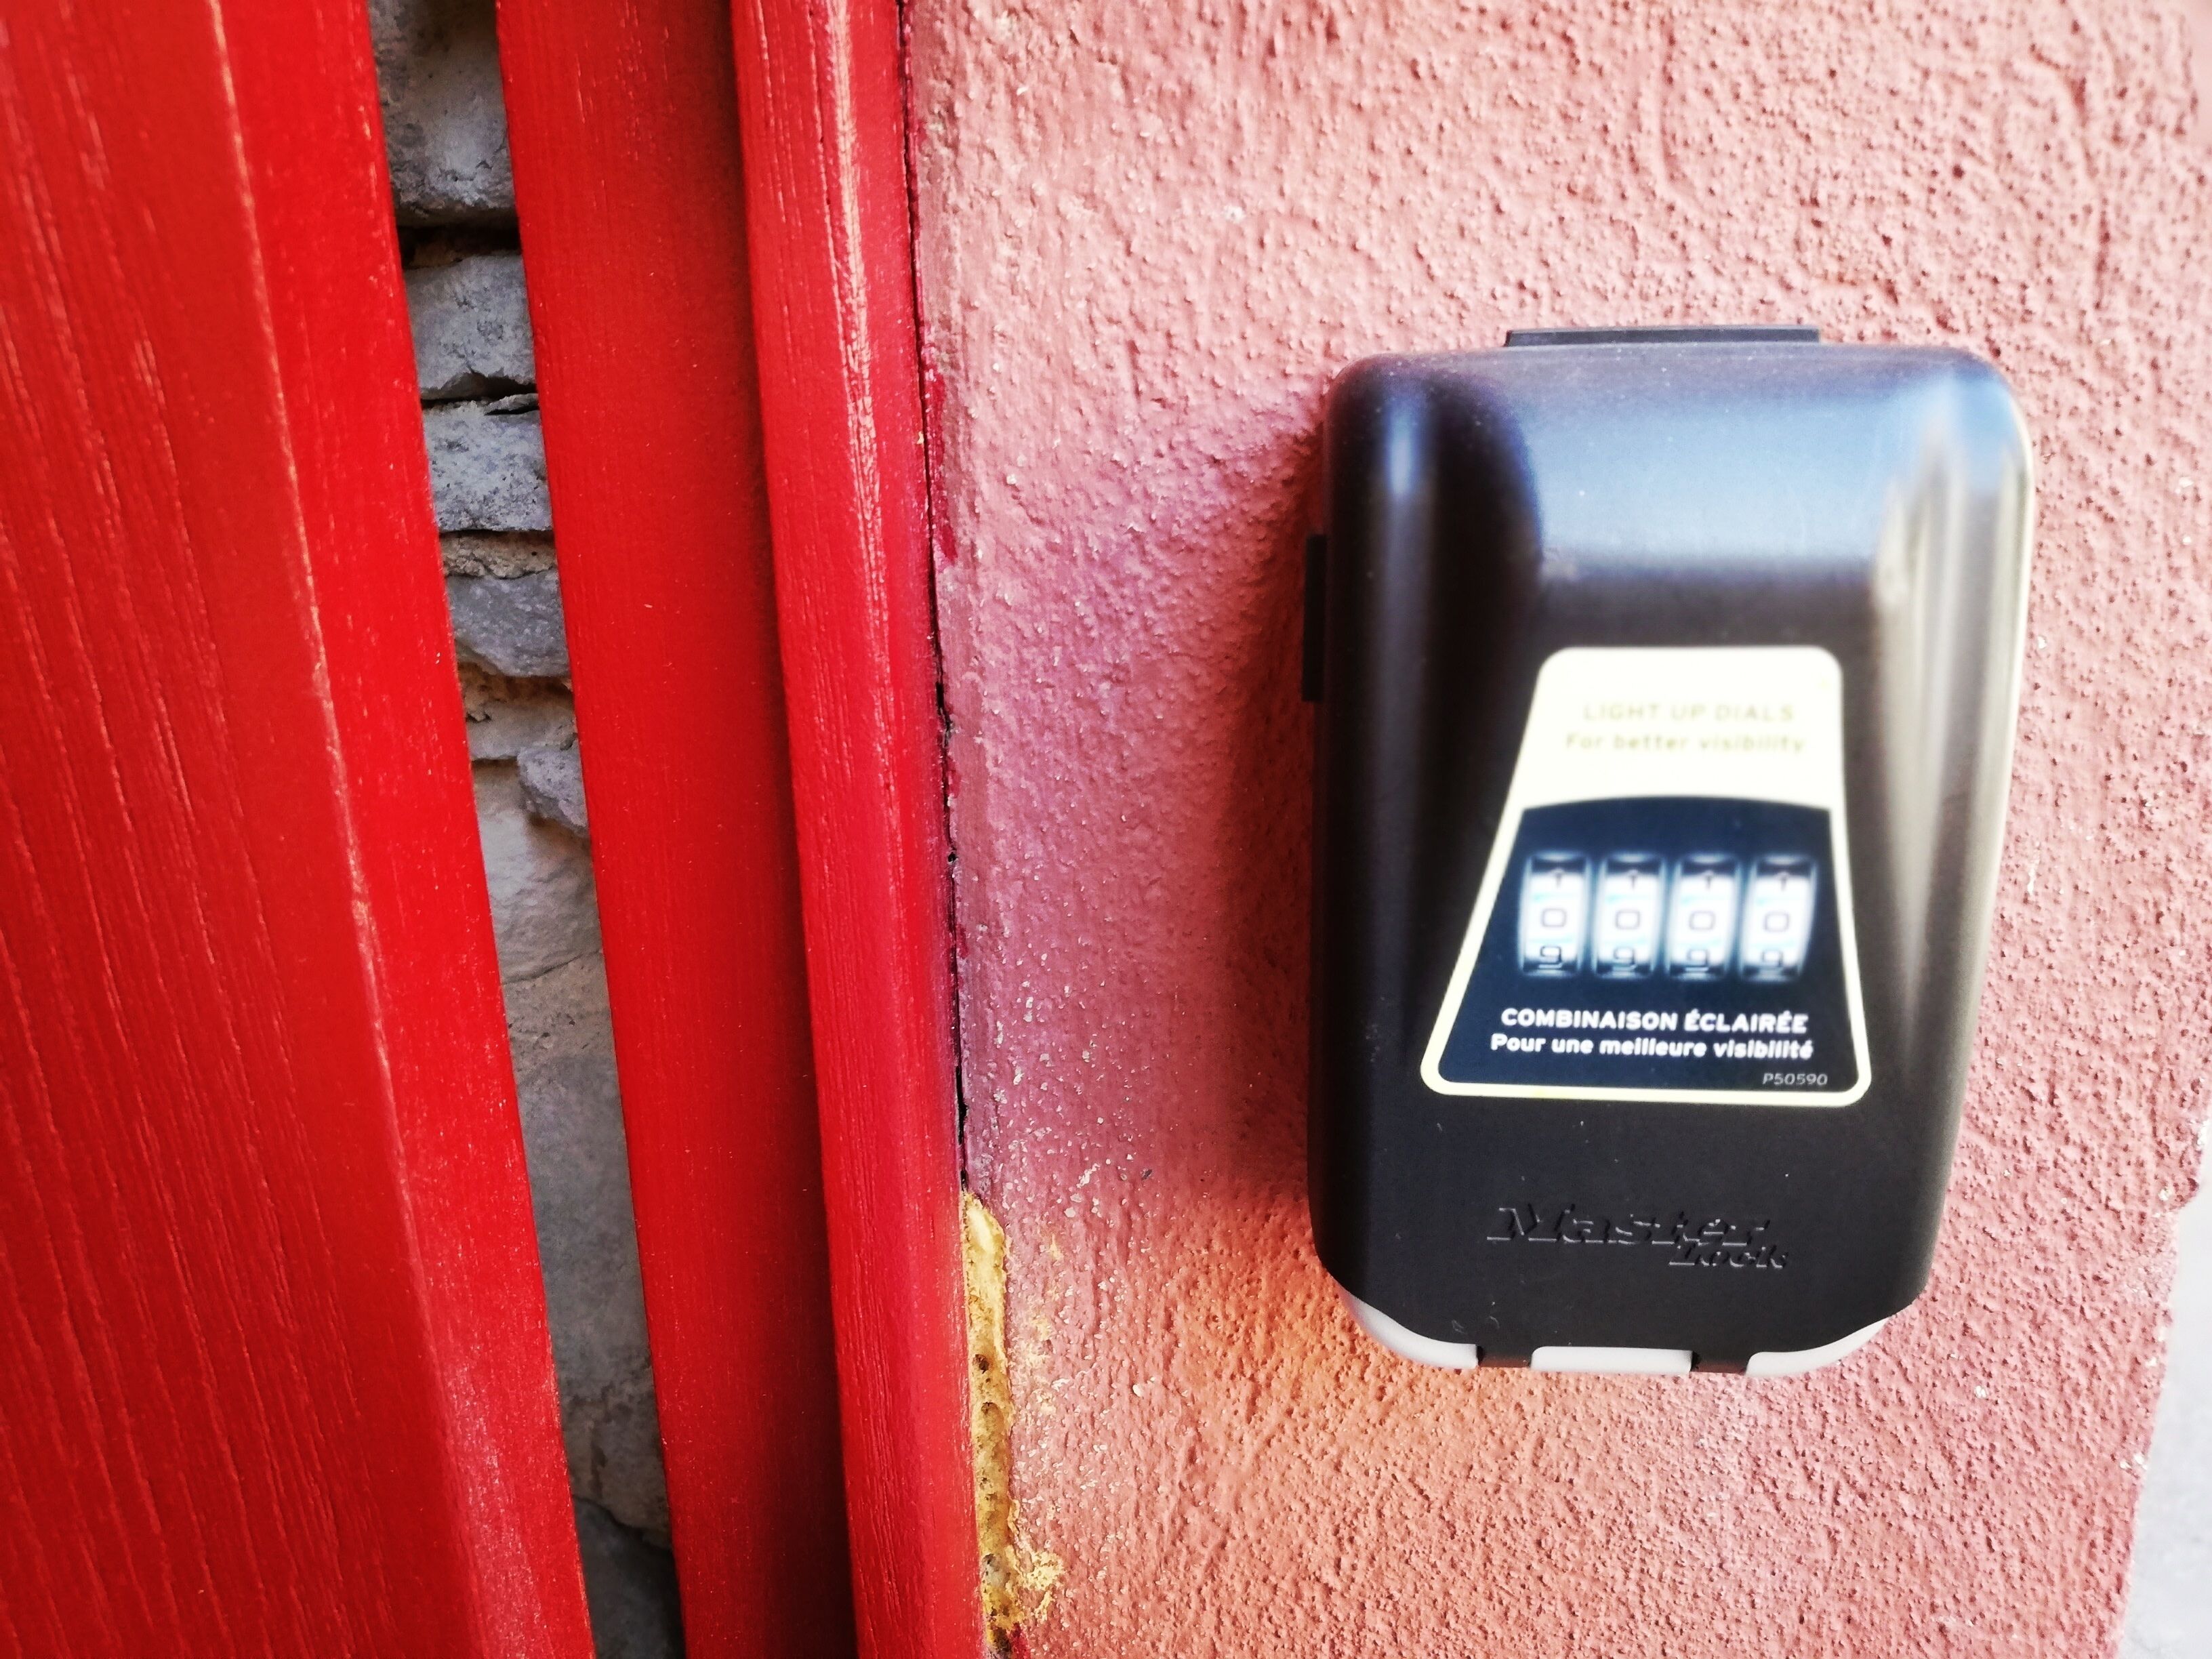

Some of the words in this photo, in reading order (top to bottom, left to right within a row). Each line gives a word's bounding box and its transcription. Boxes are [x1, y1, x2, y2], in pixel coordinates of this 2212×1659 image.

[1584, 703, 1660, 721] LIGHT
[1672, 704, 1706, 721] UP
[1715, 705, 1795, 722] DIALS
[1567, 733, 1603, 749] For
[1614, 734, 1687, 750] better
[1700, 735, 1805, 753] visibility
[1500, 1008, 1677, 1031] COMBINAISON
[1683, 1008, 1809, 1035] ÉCLAIRÉE
[1491, 1033, 1546, 1052] Pour
[1551, 1038, 1593, 1054] une
[1599, 1038, 1706, 1058] meilleure
[1713, 1042, 1814, 1060] visibilité
[1763, 1072, 1828, 1086] P50590
[1487, 1204, 1770, 1248] Master
[1668, 1245, 1789, 1269] Lock
